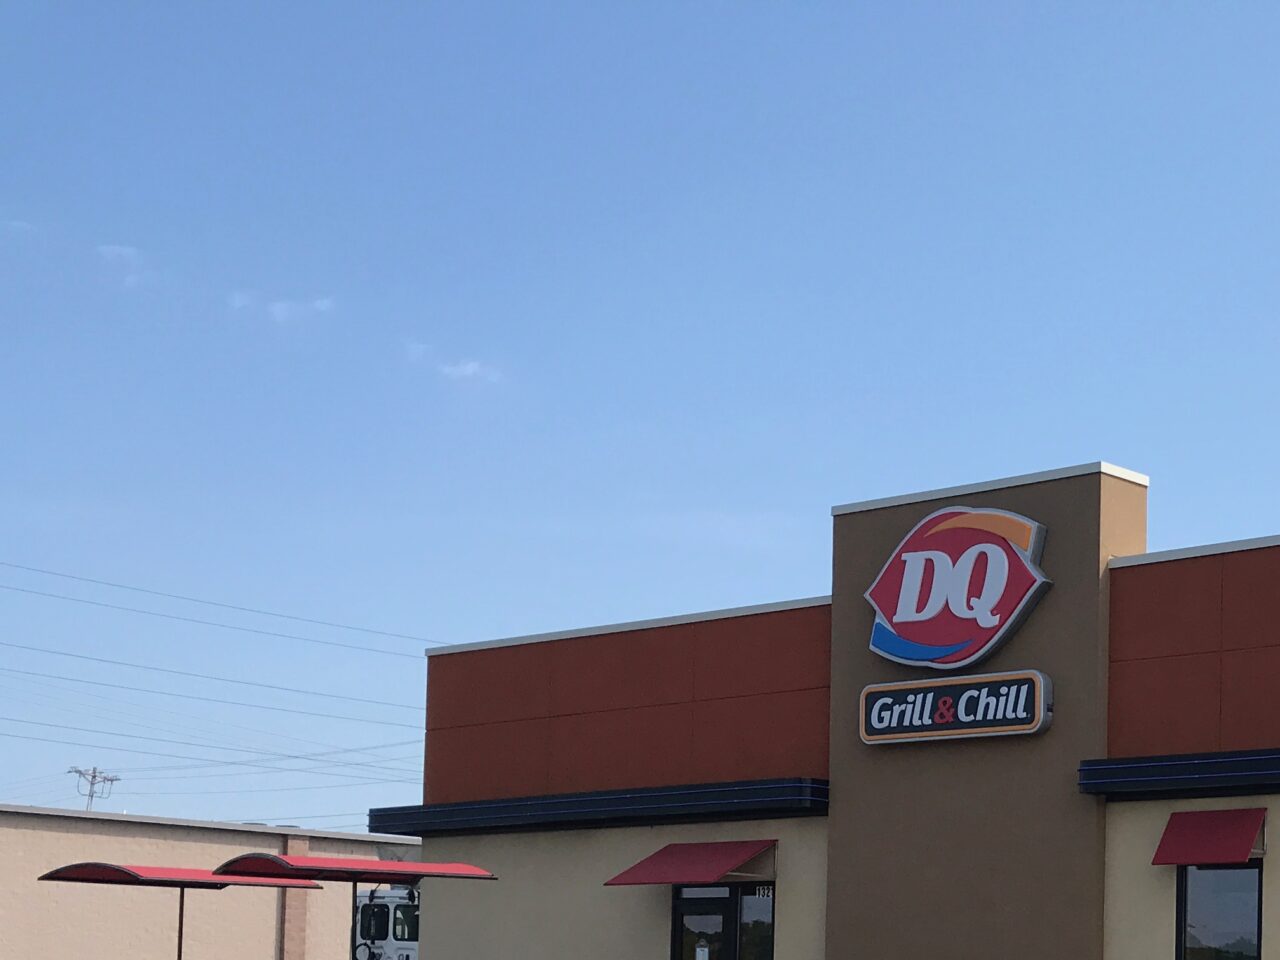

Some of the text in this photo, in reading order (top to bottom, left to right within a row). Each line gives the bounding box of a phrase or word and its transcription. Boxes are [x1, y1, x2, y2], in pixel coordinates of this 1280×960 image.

[893, 543, 1009, 629] DQ
[870, 691, 934, 729] Grill
[957, 683, 1029, 723] Chill
